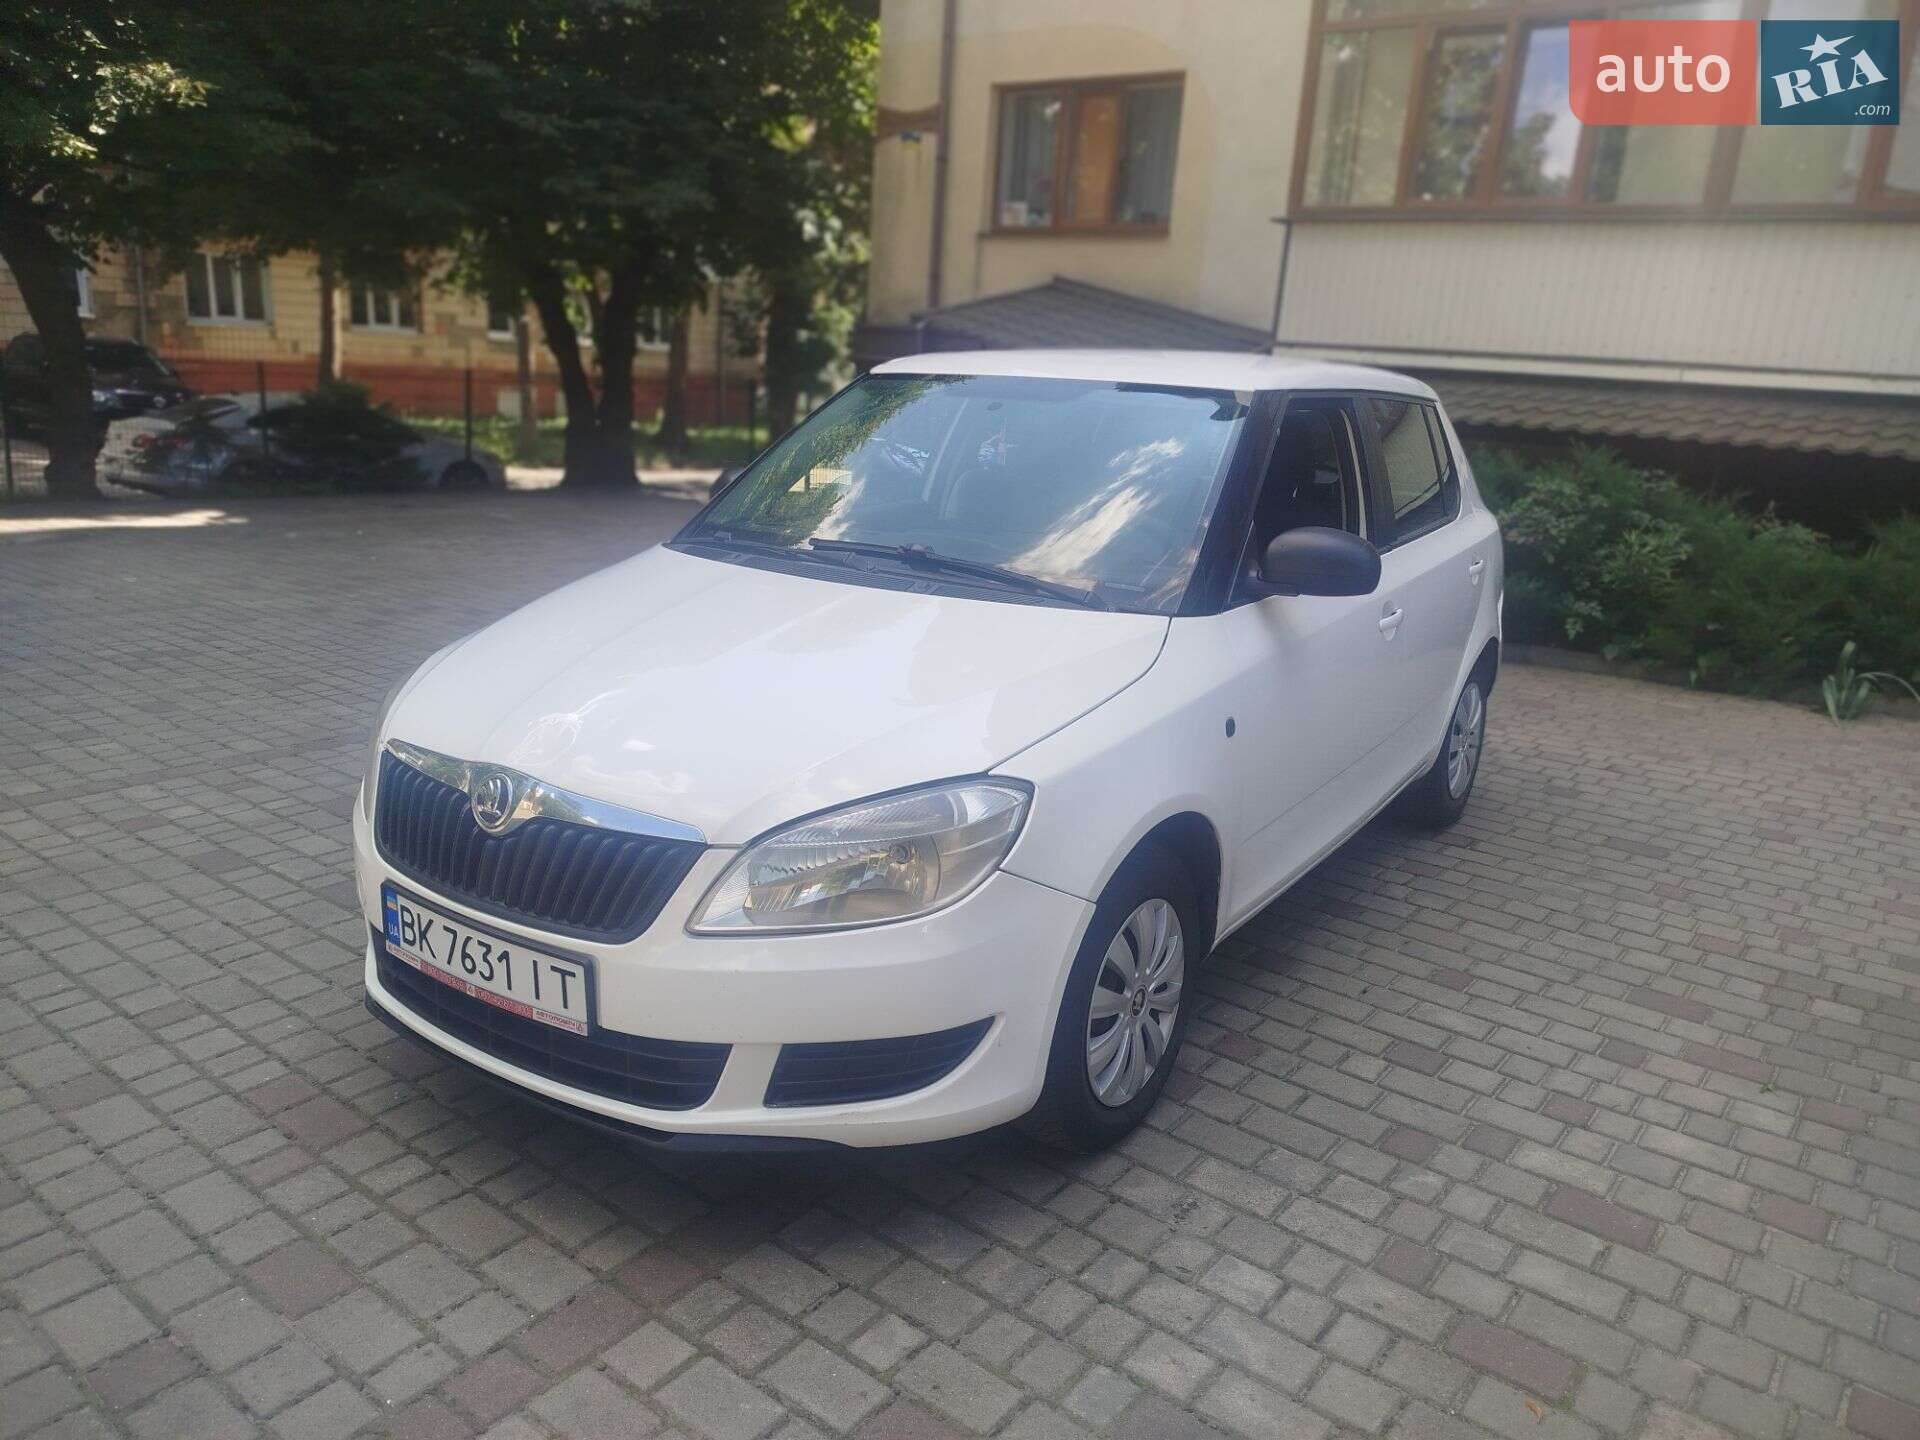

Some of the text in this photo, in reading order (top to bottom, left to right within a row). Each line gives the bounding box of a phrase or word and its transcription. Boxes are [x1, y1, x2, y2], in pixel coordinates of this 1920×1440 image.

[388, 922, 399, 938] UA
[400, 904, 436, 960] BK
[443, 925, 513, 991] 7631
[532, 959, 576, 1010] IT
